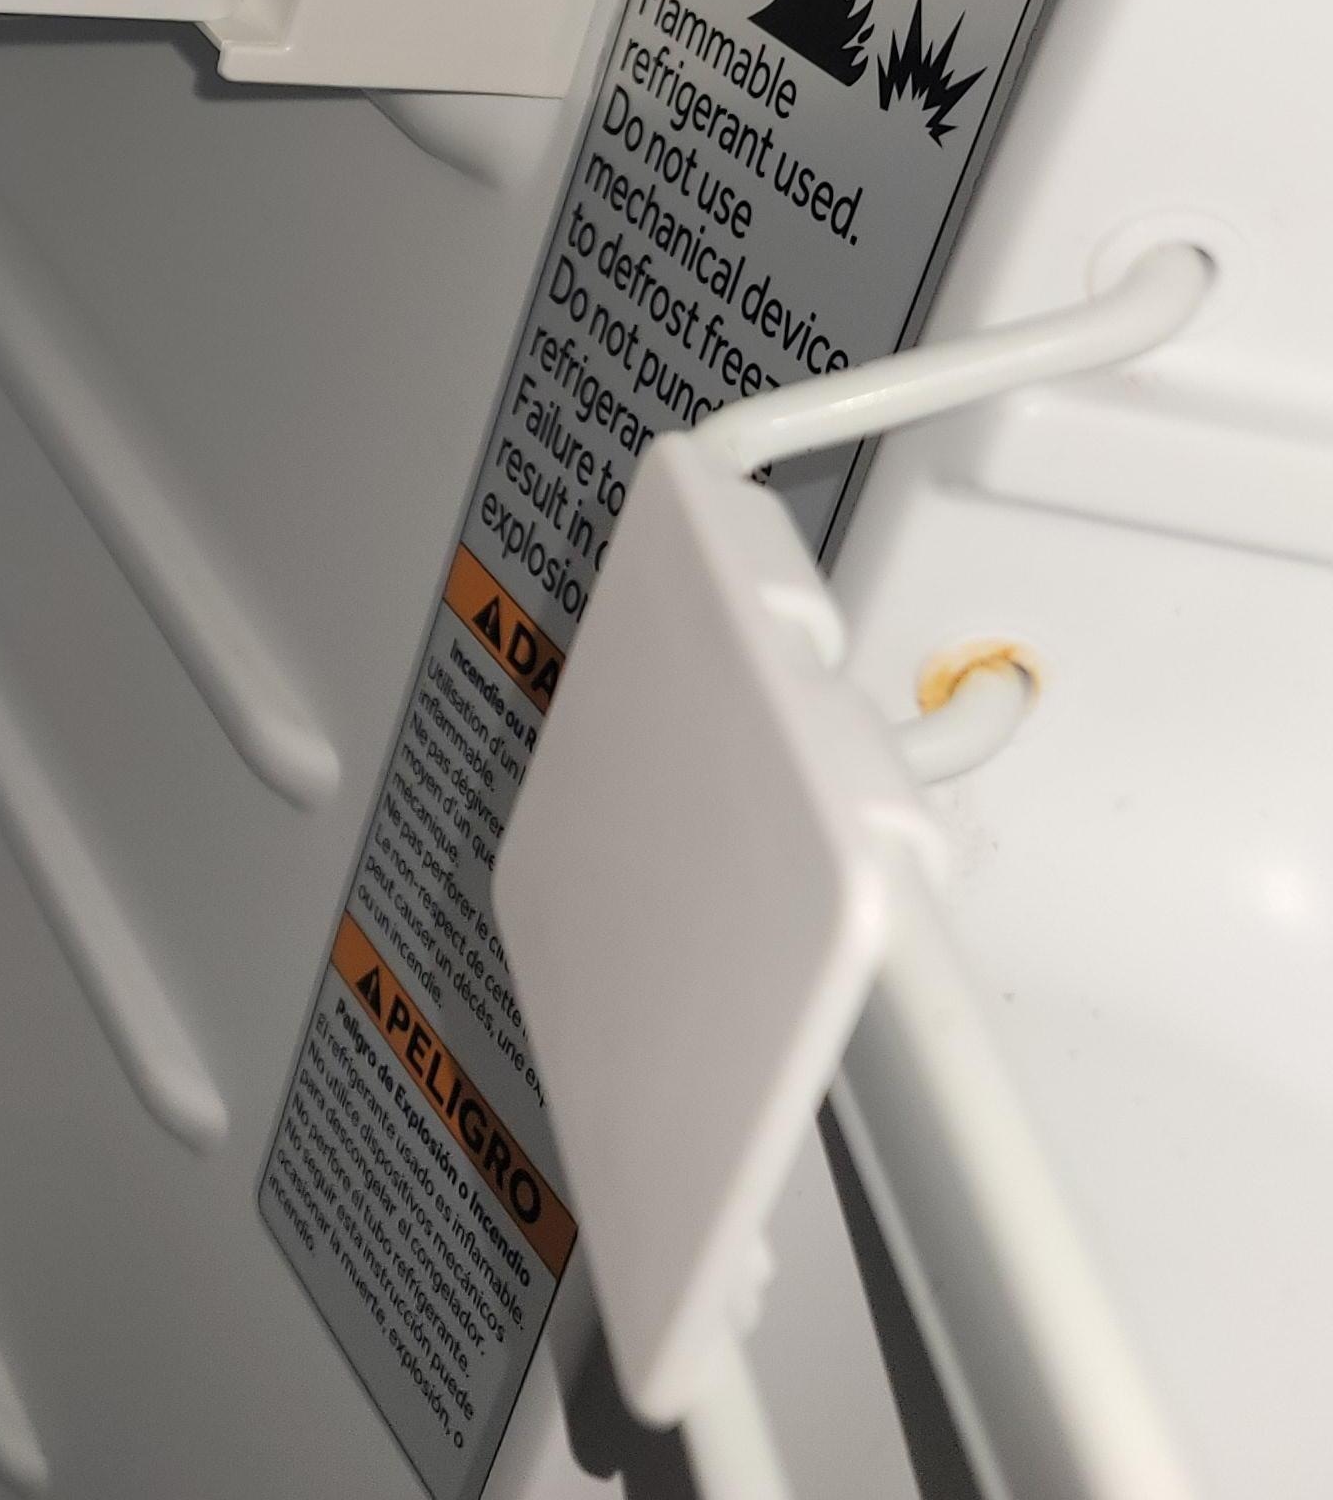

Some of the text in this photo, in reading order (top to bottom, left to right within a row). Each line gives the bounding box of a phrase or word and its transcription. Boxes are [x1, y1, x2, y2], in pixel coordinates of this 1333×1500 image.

[602, 84, 753, 239] Do not use
[619, 38, 864, 247] refrigerant used.
[568, 202, 595, 258] to
[597, 233, 699, 350] defrost
[584, 152, 747, 305] mechanical
[549, 253, 589, 322] Do
[589, 303, 639, 371] not
[496, 437, 569, 530] result
[566, 498, 594, 558] in
[511, 372, 626, 517] Failure to
[410, 711, 428, 747] Ne
[427, 741, 451, 775] pas
[420, 688, 494, 793] inflammable.
[428, 656, 518, 780] Utilisation d'un
[450, 638, 524, 739] Incendie ou
[383, 791, 488, 940] Ne pas perforer le
[393, 772, 459, 869] mécanique.
[403, 744, 443, 803] moyen
[443, 796, 470, 839] d'un
[358, 884, 443, 1010] ou un incendie.
[365, 855, 394, 900] peut
[394, 893, 436, 951] causer
[435, 947, 451, 978] un
[496, 1030, 525, 1071] une
[375, 823, 390, 855] Le
[390, 850, 466, 956] non-respect
[466, 950, 484, 979] de
[485, 974, 521, 1027] cette
[317, 1013, 523, 1330] El refrigerante usado es inflamable.
[335, 997, 530, 1287] Peligro de Explosión o Incendio
[385, 994, 542, 1225] PELIGRO
[285, 1117, 302, 1151] No
[302, 1148, 337, 1204] seguir
[336, 1204, 363, 1250] esta
[429, 1353, 474, 1420] puede
[293, 1091, 469, 1378] No perfore el tubo refrigerante.
[300, 1068, 485, 1355] para descongelar el congelador.
[308, 1041, 505, 1343] No utilice dispositivos mecánicos
[277, 1149, 330, 1234] ocasionar
[330, 1229, 340, 1255] la
[340, 1253, 386, 1332] muerte,
[453, 1431, 464, 1448] o
